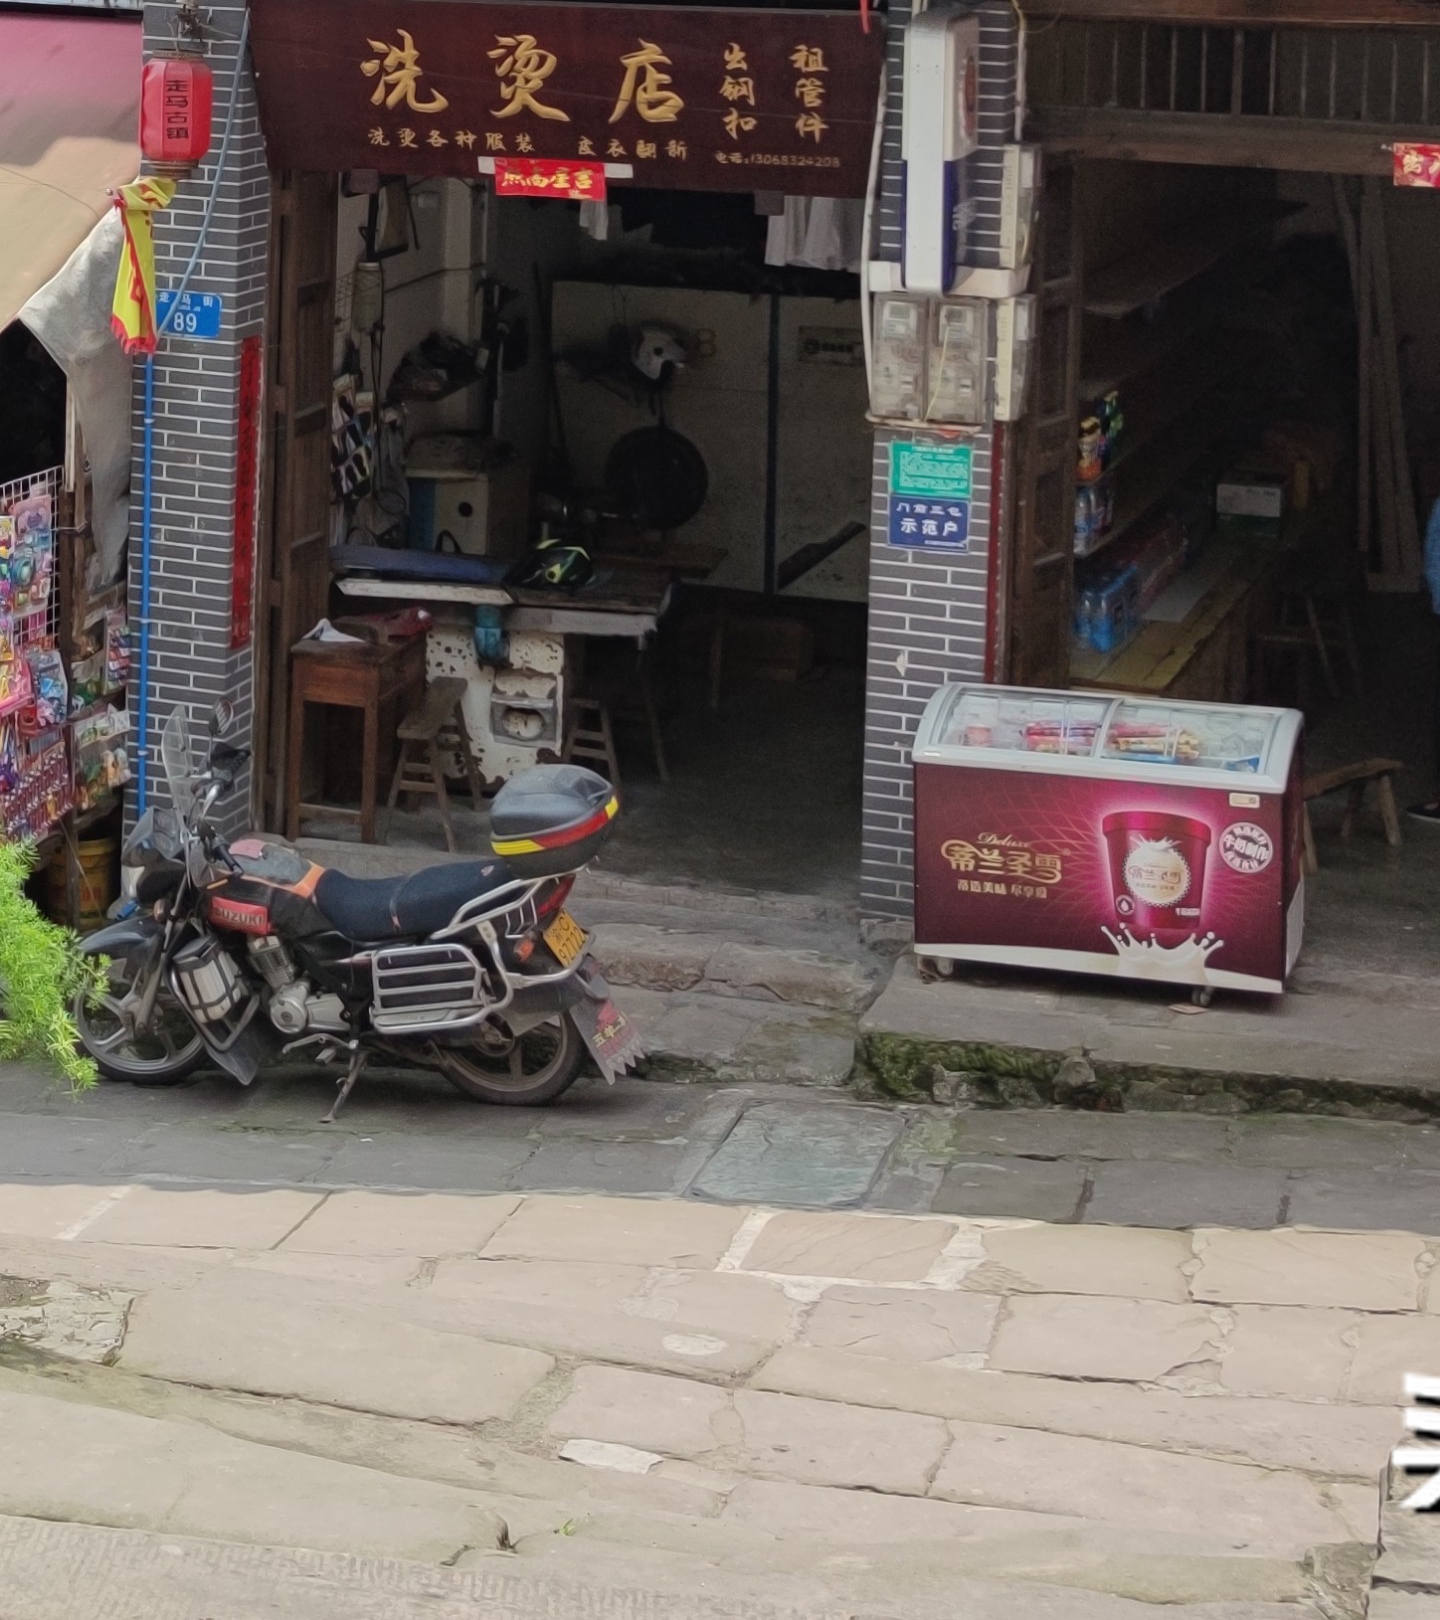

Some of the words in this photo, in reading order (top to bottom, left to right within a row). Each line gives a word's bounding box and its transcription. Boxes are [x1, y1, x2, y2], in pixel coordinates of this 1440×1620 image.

[360, 29, 685, 123] 洗烫店
[165, 79, 189, 139] 走马古镇
[368, 127, 536, 152] 洗烫各种服装
[578, 135, 687, 160] 皮衣翻新
[173, 312, 197, 333] 89
[900, 517, 958, 536] 示范户
[941, 839, 1062, 884] 蒂兰圣雪
